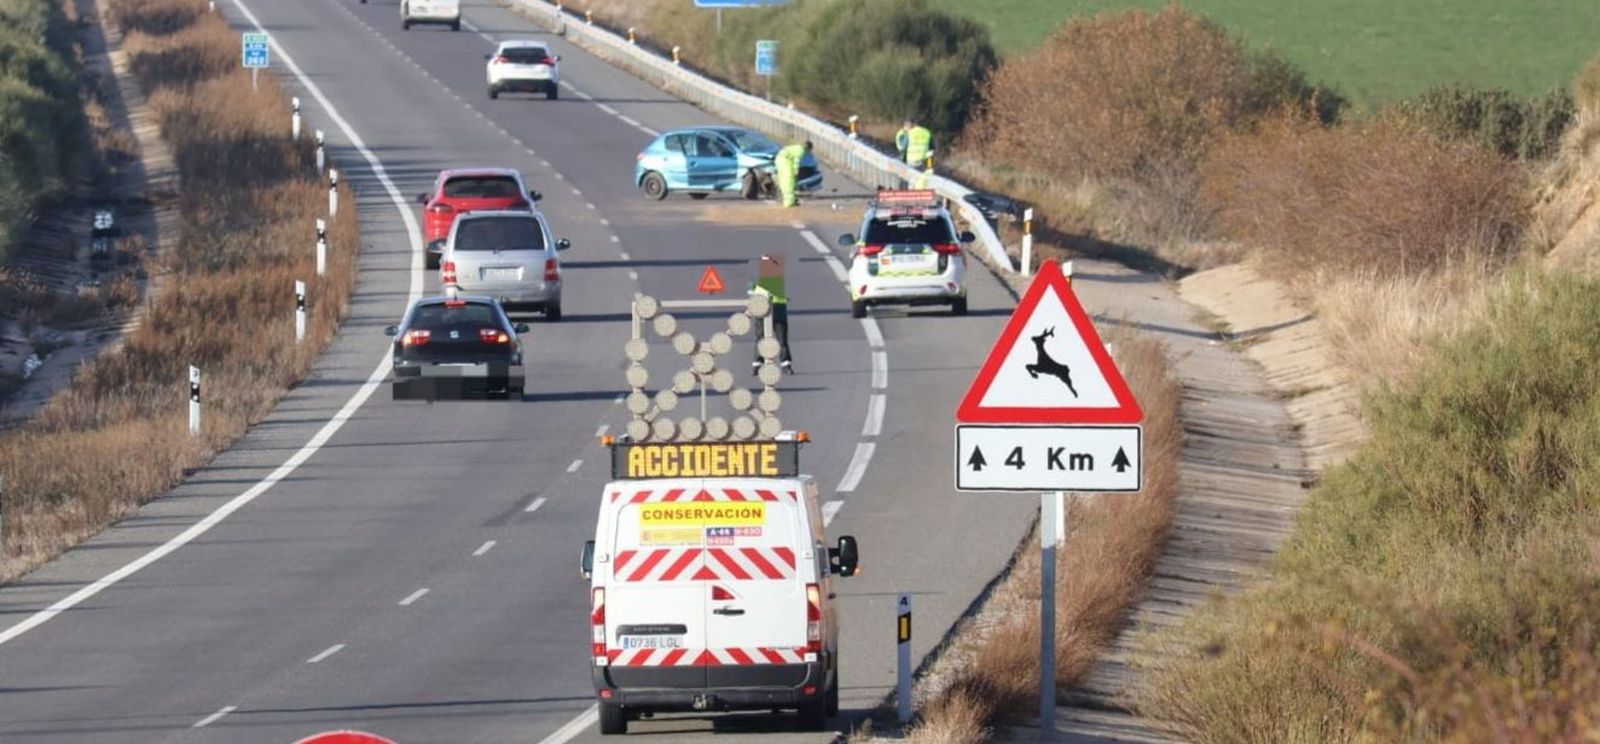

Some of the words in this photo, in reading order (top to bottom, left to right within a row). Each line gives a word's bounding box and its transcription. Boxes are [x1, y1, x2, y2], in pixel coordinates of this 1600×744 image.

[628, 445, 778, 477] ACCIDENTE
[1004, 446, 1026, 470] 4
[1047, 447, 1094, 471] Km
[642, 507, 762, 520] CONSERVACIÓN
[900, 596, 908, 605] 4
[630, 637, 657, 648] 0736
